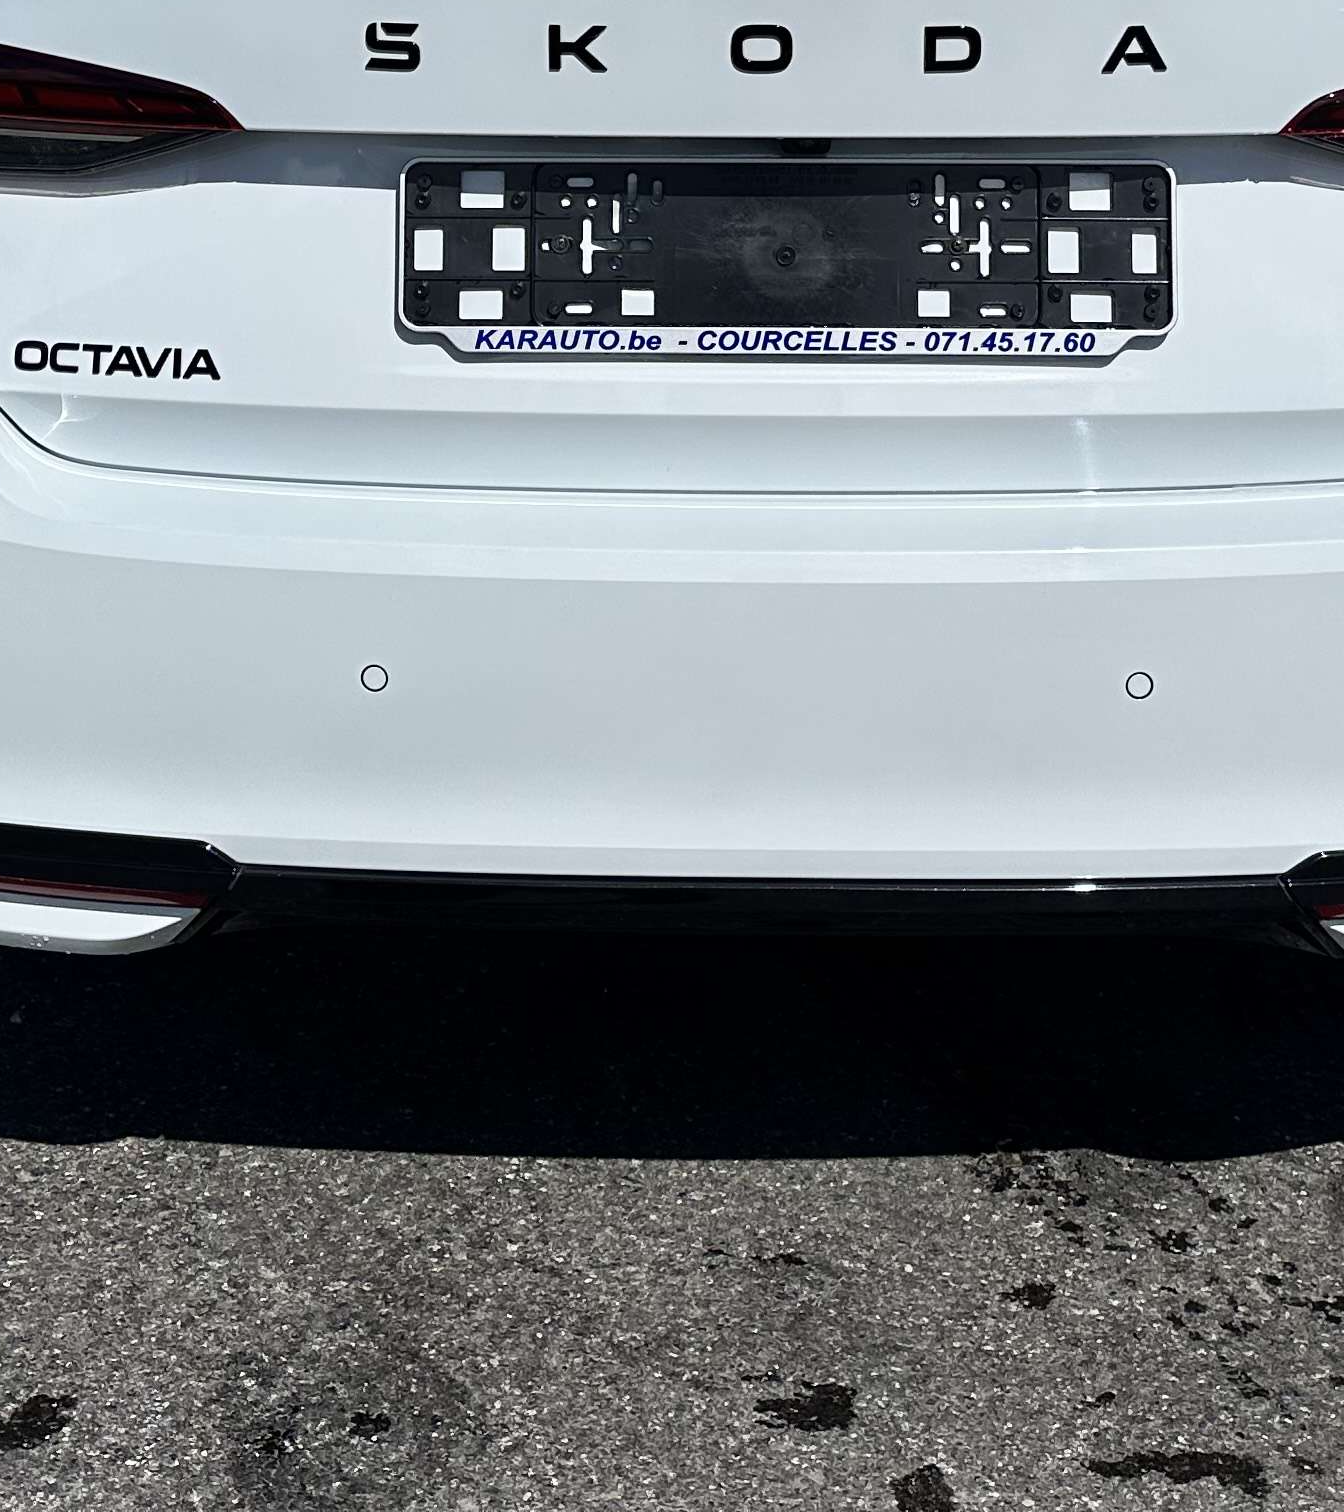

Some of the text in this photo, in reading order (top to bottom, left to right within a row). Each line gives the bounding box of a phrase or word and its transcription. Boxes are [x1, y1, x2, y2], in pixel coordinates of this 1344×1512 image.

[364, 22, 1168, 75] SKODA
[14, 340, 221, 381] OCTAVIA
[474, 329, 662, 351] KARAUTO.be
[697, 330, 898, 352] COURCELLES
[923, 331, 1096, 353] 071.45.17.60
